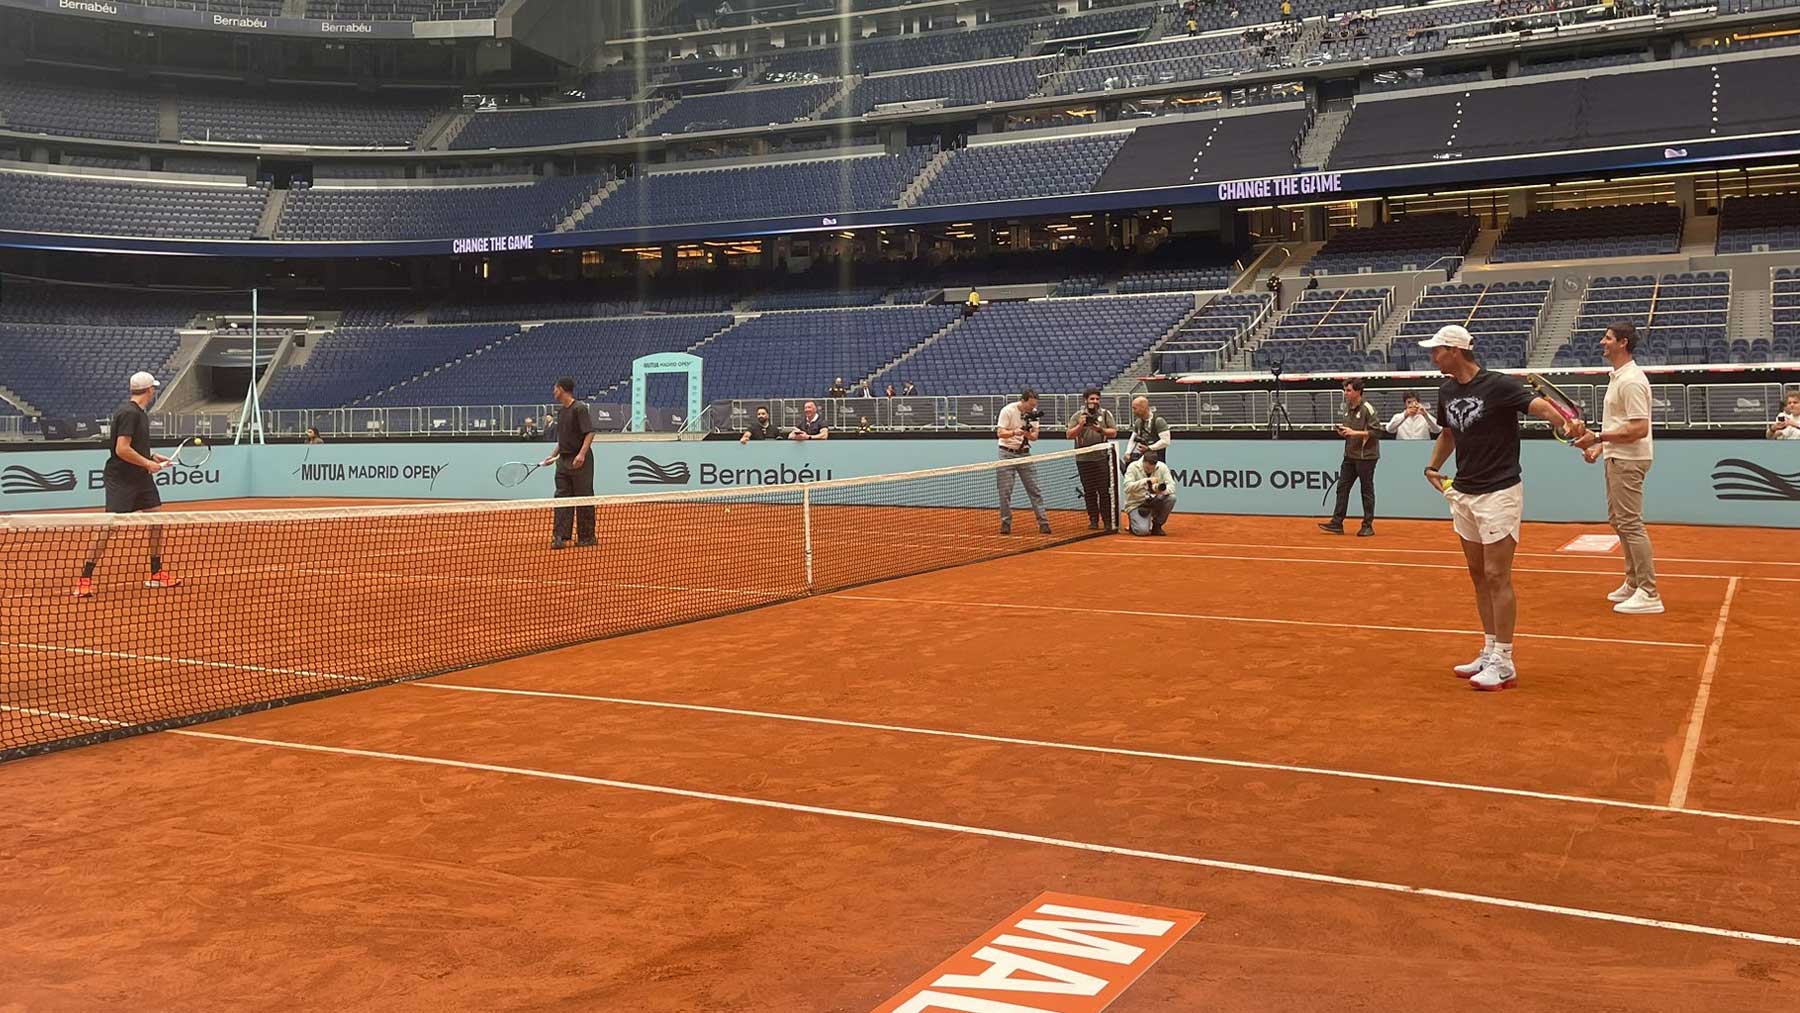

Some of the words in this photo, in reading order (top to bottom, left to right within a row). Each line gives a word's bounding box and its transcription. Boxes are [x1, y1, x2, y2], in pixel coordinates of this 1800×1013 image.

[59, 0, 117, 14] Bernabéu
[213, 15, 267, 29] Bernabéu
[321, 22, 372, 33] Bernabéu
[1218, 179, 1271, 201] CHANGE
[1273, 178, 1299, 196] THE
[1301, 174, 1342, 194] GAME
[453, 238, 489, 254] CHANGE
[490, 236, 507, 251] THE
[508, 234, 534, 249] GAME
[88, 464, 220, 490] Babéu
[301, 464, 345, 481] MUTUA
[348, 465, 399, 479] MADRID
[402, 465, 440, 479] OPEN
[700, 463, 832, 485] Bernabéu
[1171, 470, 1262, 489] MADRID
[1270, 470, 1340, 489] OPEN
